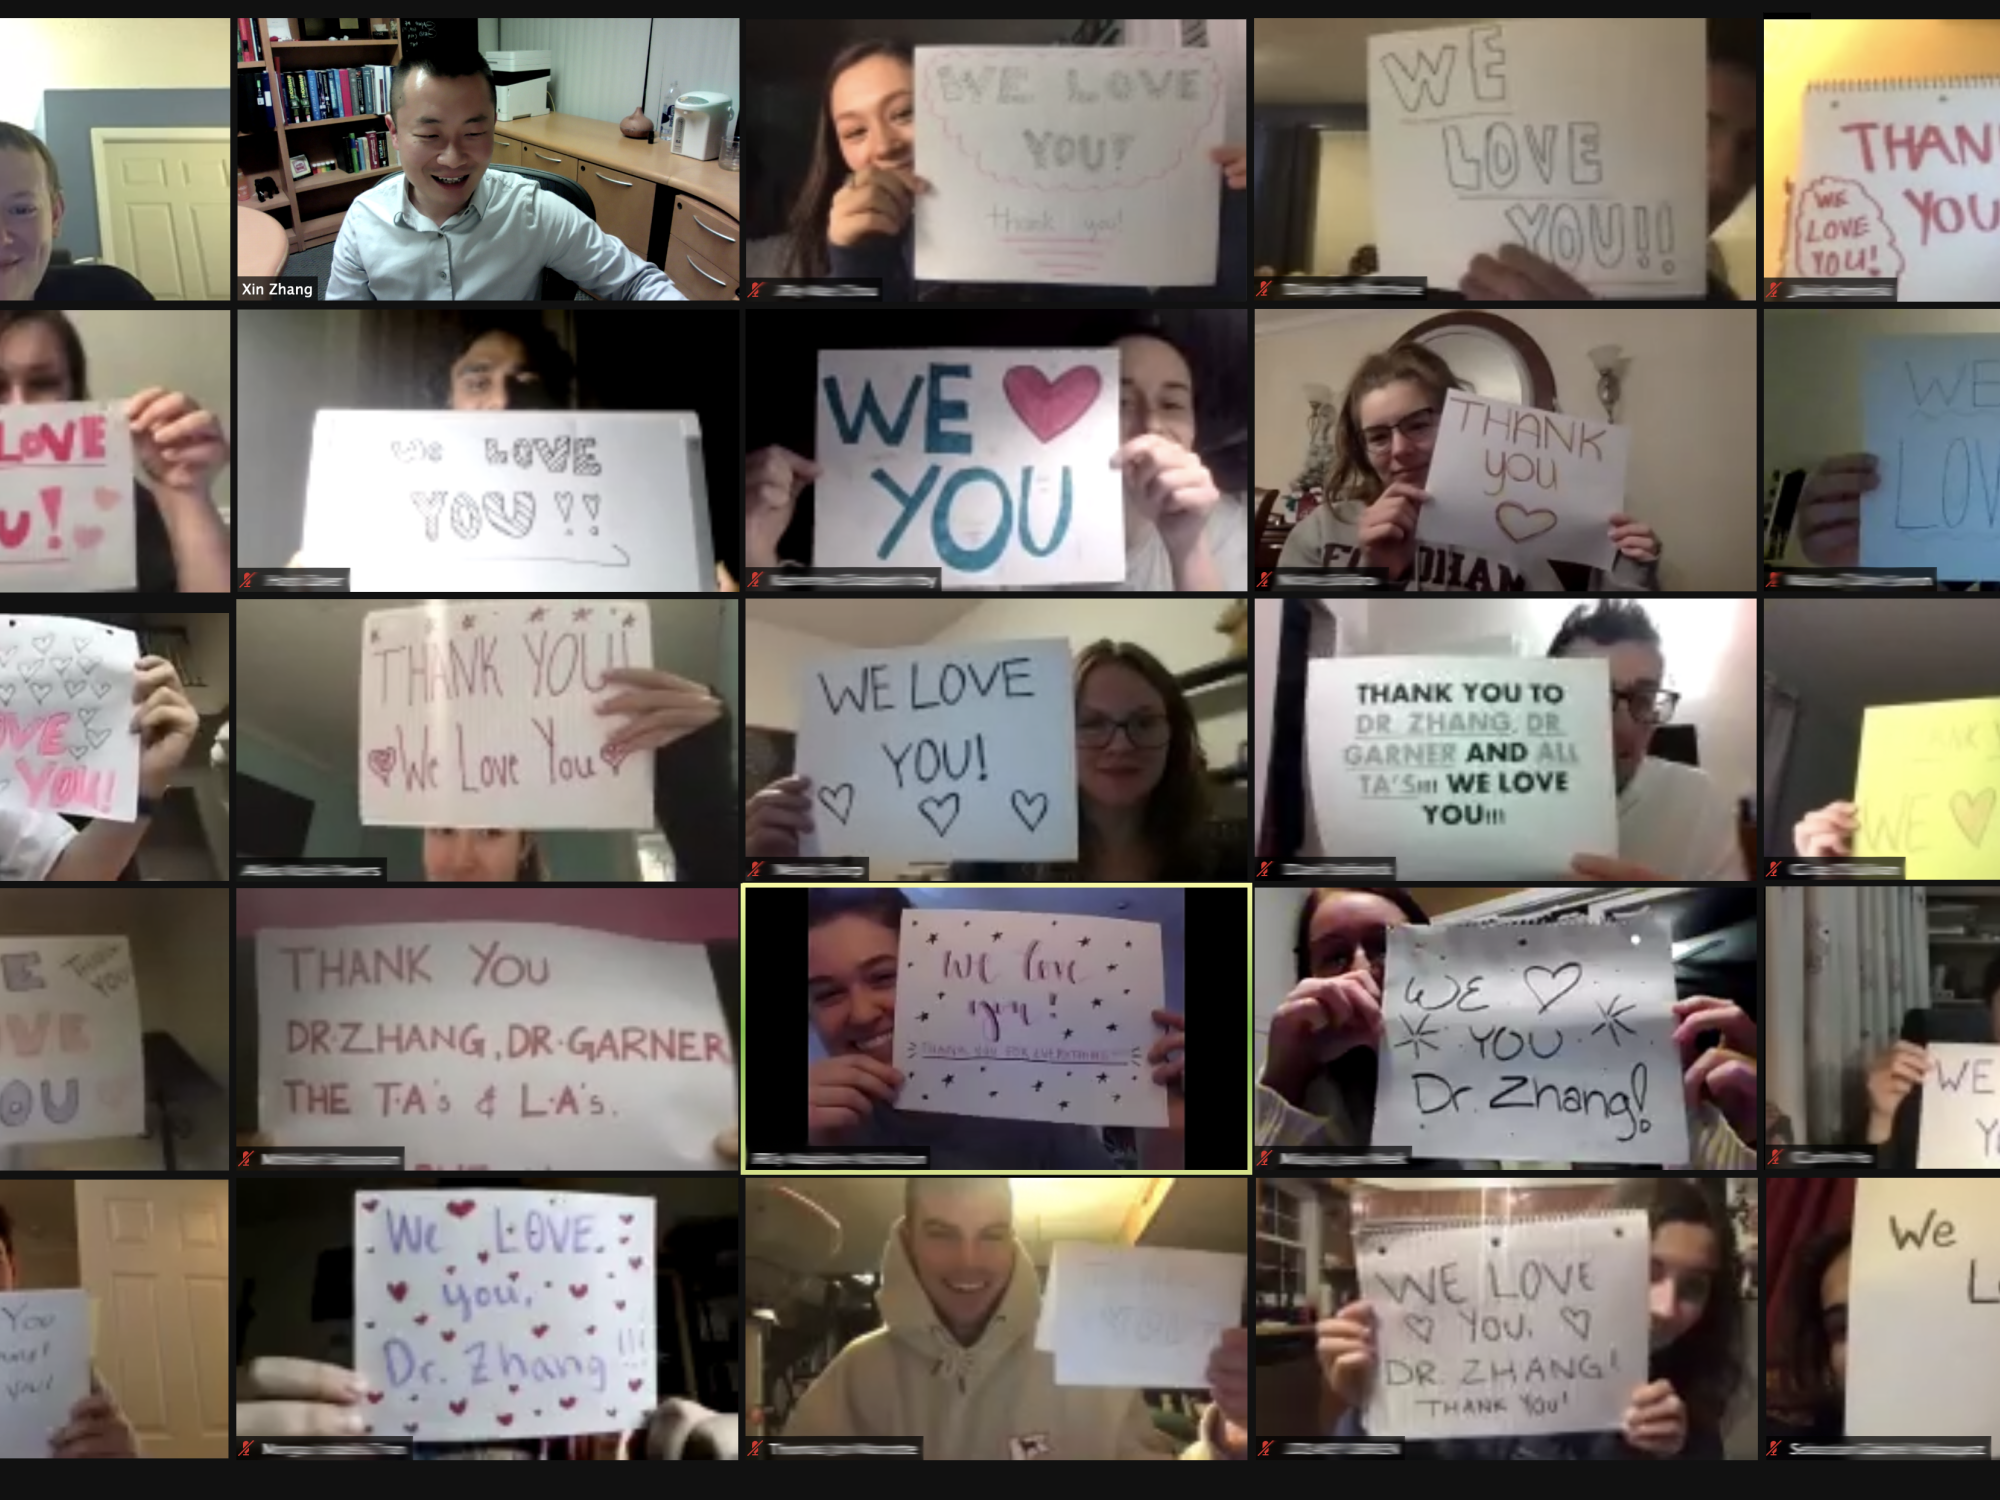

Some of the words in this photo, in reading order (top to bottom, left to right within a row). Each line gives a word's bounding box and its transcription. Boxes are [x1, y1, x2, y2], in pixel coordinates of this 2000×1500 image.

[1066, 67, 1202, 104] LOVE
[1379, 26, 1507, 113] WE
[1442, 121, 1603, 191] LOVE
[1840, 122, 2000, 173] THAN
[1805, 215, 1872, 244] LOVE
[822, 362, 974, 454] WE
[1448, 396, 1608, 462] THANK
[485, 435, 602, 477] LOVE
[870, 464, 1074, 574] YOU
[373, 632, 504, 707] THANK
[816, 663, 895, 716] WE
[911, 656, 1036, 711] LOVE
[1356, 682, 1453, 705] THANK
[1462, 682, 1522, 704] YOU
[1528, 683, 1565, 705] TO
[880, 732, 990, 789] YOU!
[1344, 742, 1457, 767] GARNER
[1465, 741, 1529, 764] AND
[1446, 772, 1491, 795] WE
[1499, 770, 1570, 795] LOVE
[280, 942, 433, 992] THANK
[1404, 974, 1491, 1012] WE
[0, 1011, 92, 1057] VE
[1468, 1025, 1564, 1061] YOU
[282, 1078, 352, 1116] THE
[1935, 1058, 1995, 1095] WE
[1488, 1062, 1652, 1142] Zhang!
[1889, 1208, 1957, 1251] We
[1375, 1262, 1466, 1305] WE
[1487, 1260, 1597, 1302] LOVE
[1415, 1398, 1509, 1418] THANK
